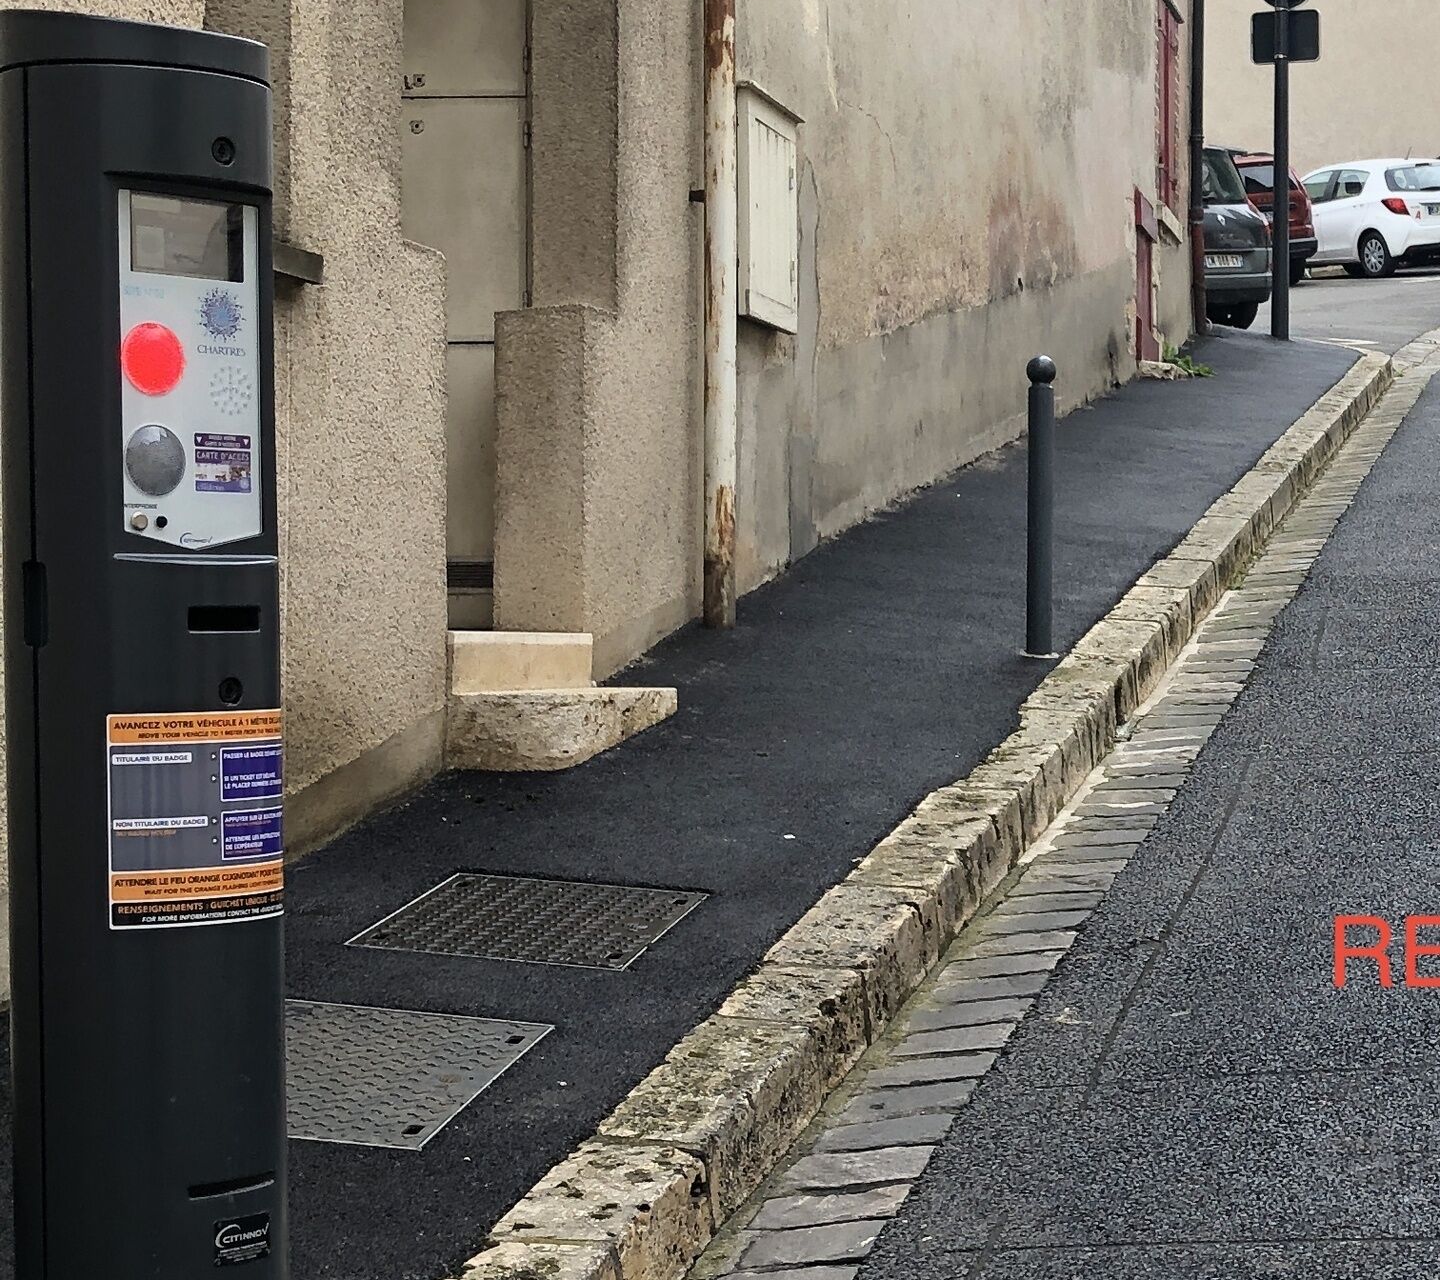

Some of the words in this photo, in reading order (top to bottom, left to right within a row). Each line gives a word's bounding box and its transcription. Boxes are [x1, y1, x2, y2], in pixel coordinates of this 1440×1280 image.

[196, 344, 246, 357] CHARTRES
[196, 451, 218, 460] CARTE
[114, 721, 161, 730] AVANCEZ
[163, 720, 194, 729] VOTRE
[197, 718, 237, 728] VÉHICULE
[115, 755, 151, 763] TITULAIRE
[164, 754, 188, 762] BADGE
[134, 820, 169, 828] TITULAIRE
[225, 834, 252, 843] ATTENDRE
[114, 877, 158, 888] ATTENDRE
[158, 877, 169, 886] LE
[170, 876, 187, 885] FEU
[187, 874, 221, 884] ORANGE
[193, 885, 221, 893] ORANGE
[117, 902, 204, 915] RENSEIGNEMENTS
[210, 898, 245, 909] GUICHET
[141, 915, 157, 923] FOR
[157, 914, 178, 922] MORE
[179, 911, 227, 921] INFORMATIONS
